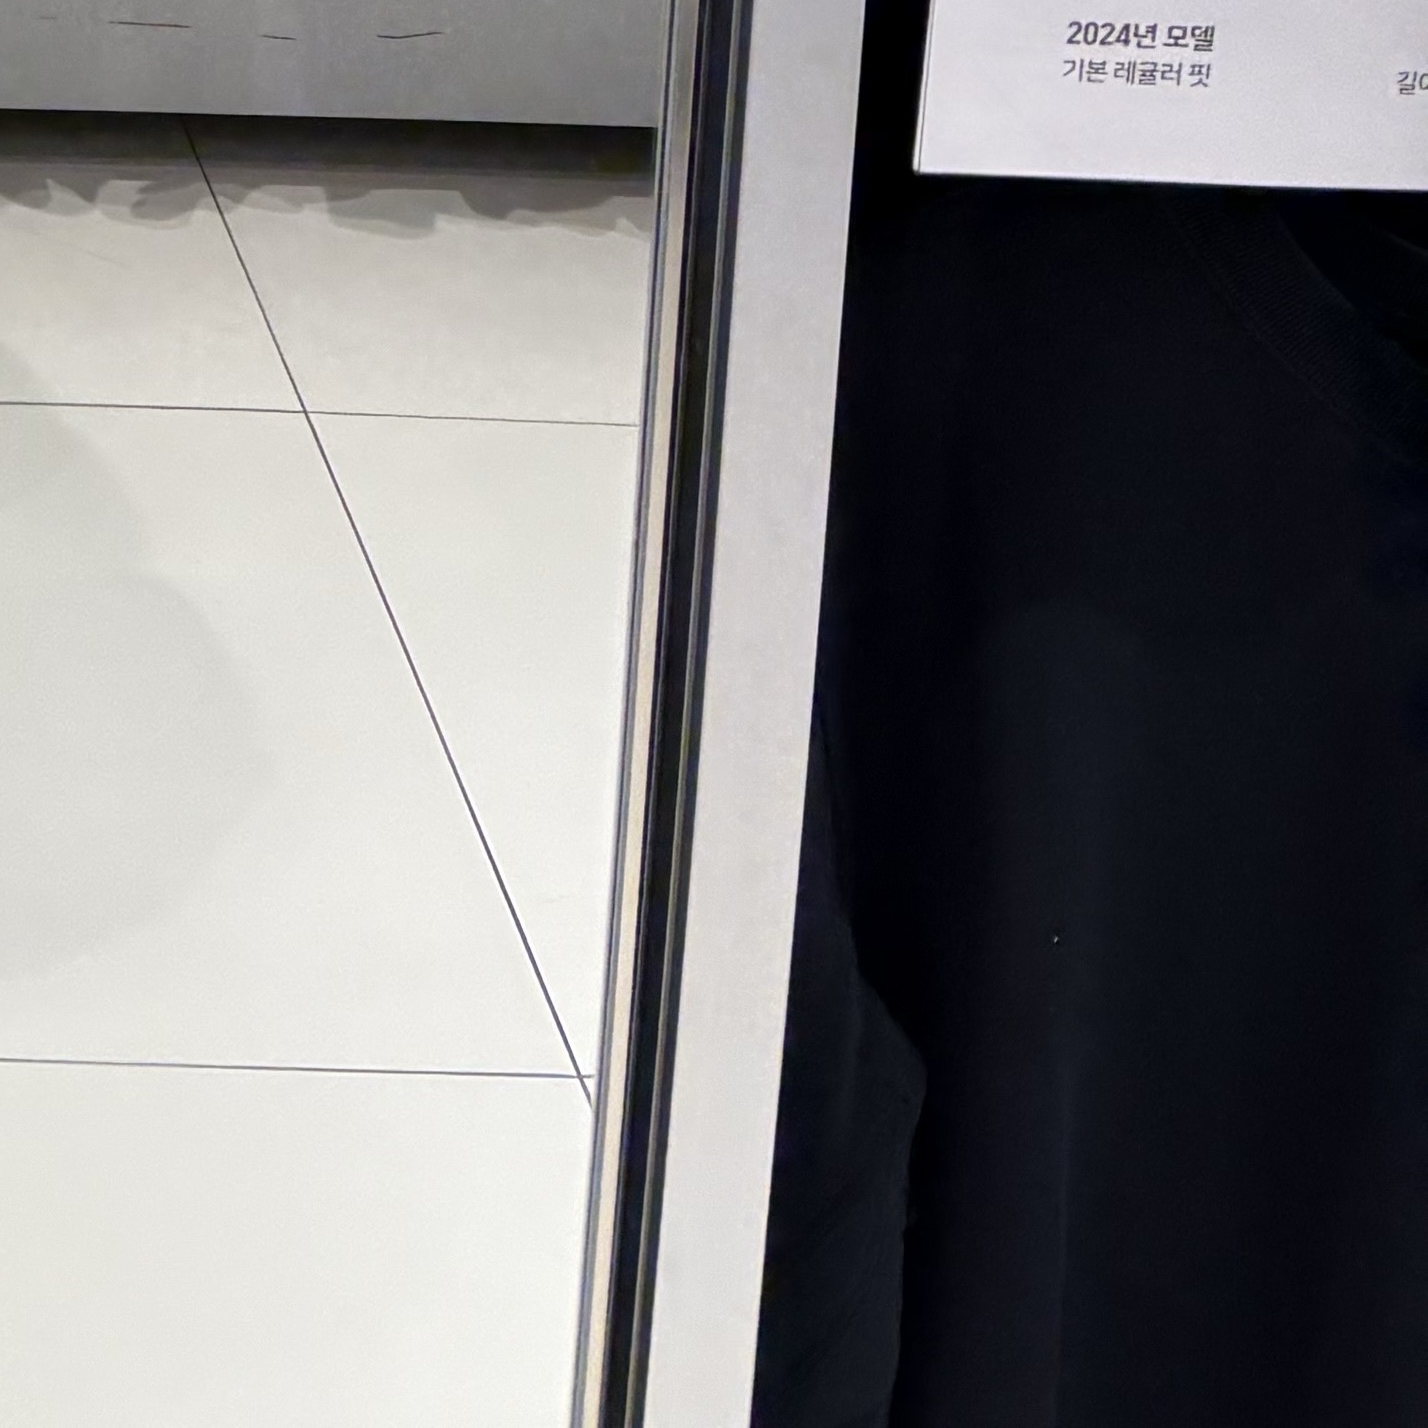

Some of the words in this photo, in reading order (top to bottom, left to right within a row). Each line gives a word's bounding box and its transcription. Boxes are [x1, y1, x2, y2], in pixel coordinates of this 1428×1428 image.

[1066, 21, 1158, 50] 2024년
[1163, 24, 1216, 52] 모델
[1062, 59, 1108, 84] 기본
[1113, 60, 1183, 87] 레귤러
[1188, 61, 1211, 88] 핏
